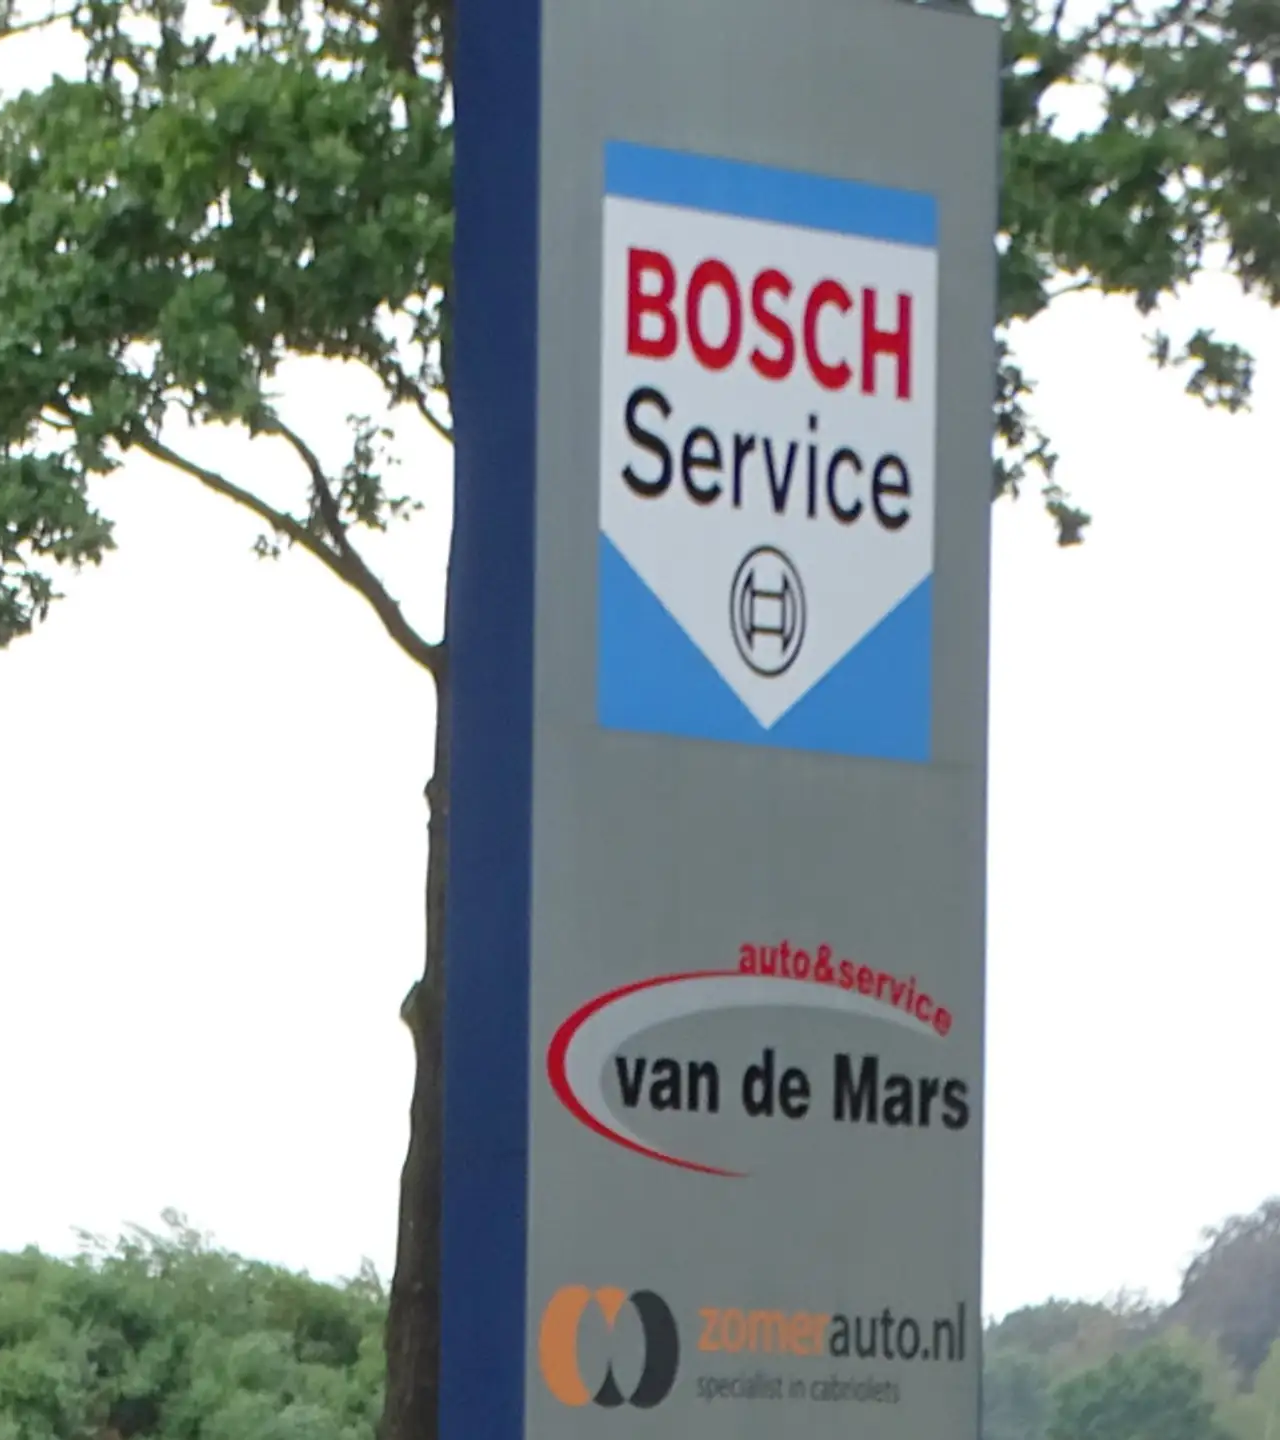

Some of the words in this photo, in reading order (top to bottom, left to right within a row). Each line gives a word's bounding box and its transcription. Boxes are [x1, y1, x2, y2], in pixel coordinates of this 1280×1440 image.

[625, 246, 913, 401] BOSCH
[621, 386, 911, 531] Service
[739, 940, 953, 1038] auto&service
[615, 1054, 720, 1114] van
[742, 1048, 811, 1118] de
[833, 1052, 970, 1131] Mars
[697, 1302, 966, 1363] zomerauto.nl
